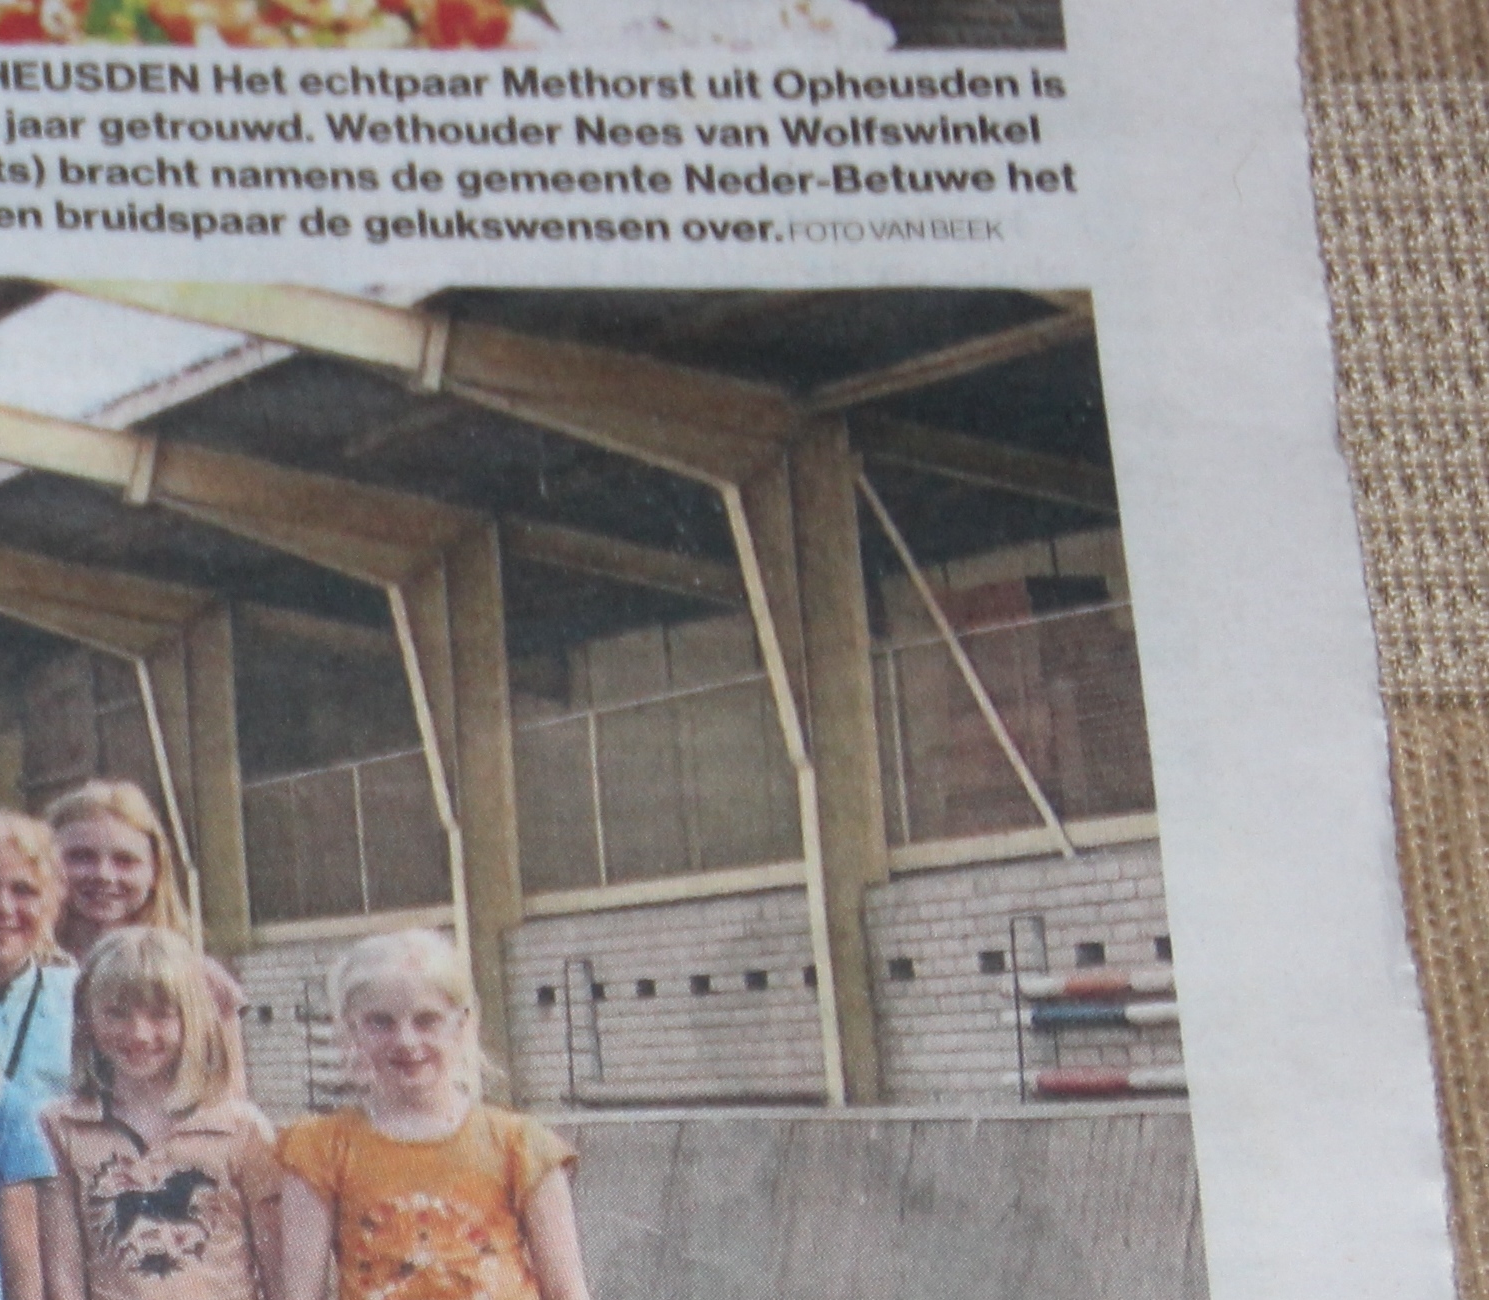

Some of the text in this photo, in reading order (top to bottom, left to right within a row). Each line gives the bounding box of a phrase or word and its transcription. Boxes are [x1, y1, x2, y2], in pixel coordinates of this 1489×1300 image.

[213, 64, 286, 95] Het
[299, 66, 488, 102] echtpaar
[503, 66, 695, 99] Methorst
[708, 68, 761, 99] uit
[773, 68, 1019, 106] Opheusden
[1032, 69, 1065, 98] is
[6, 109, 85, 144] jaar
[99, 112, 313, 146] getrouwd.
[326, 113, 561, 145] Wethouder
[575, 115, 683, 146] Nees
[696, 124, 768, 147] van
[780, 114, 1040, 147] Wolfswinkel
[59, 156, 199, 187] bracht
[212, 166, 379, 190] namens
[392, 162, 443, 192] de
[457, 164, 671, 199] gemeente
[685, 163, 995, 195] Neder-Betuwe
[1008, 161, 1076, 192] het
[55, 200, 285, 239] bruidspaar
[300, 207, 350, 237] de
[364, 209, 670, 244] gelukswensen
[681, 218, 784, 243] over.
[790, 220, 865, 243] FOTO
[869, 220, 925, 242] VAN
[930, 219, 1005, 242] BEEK
